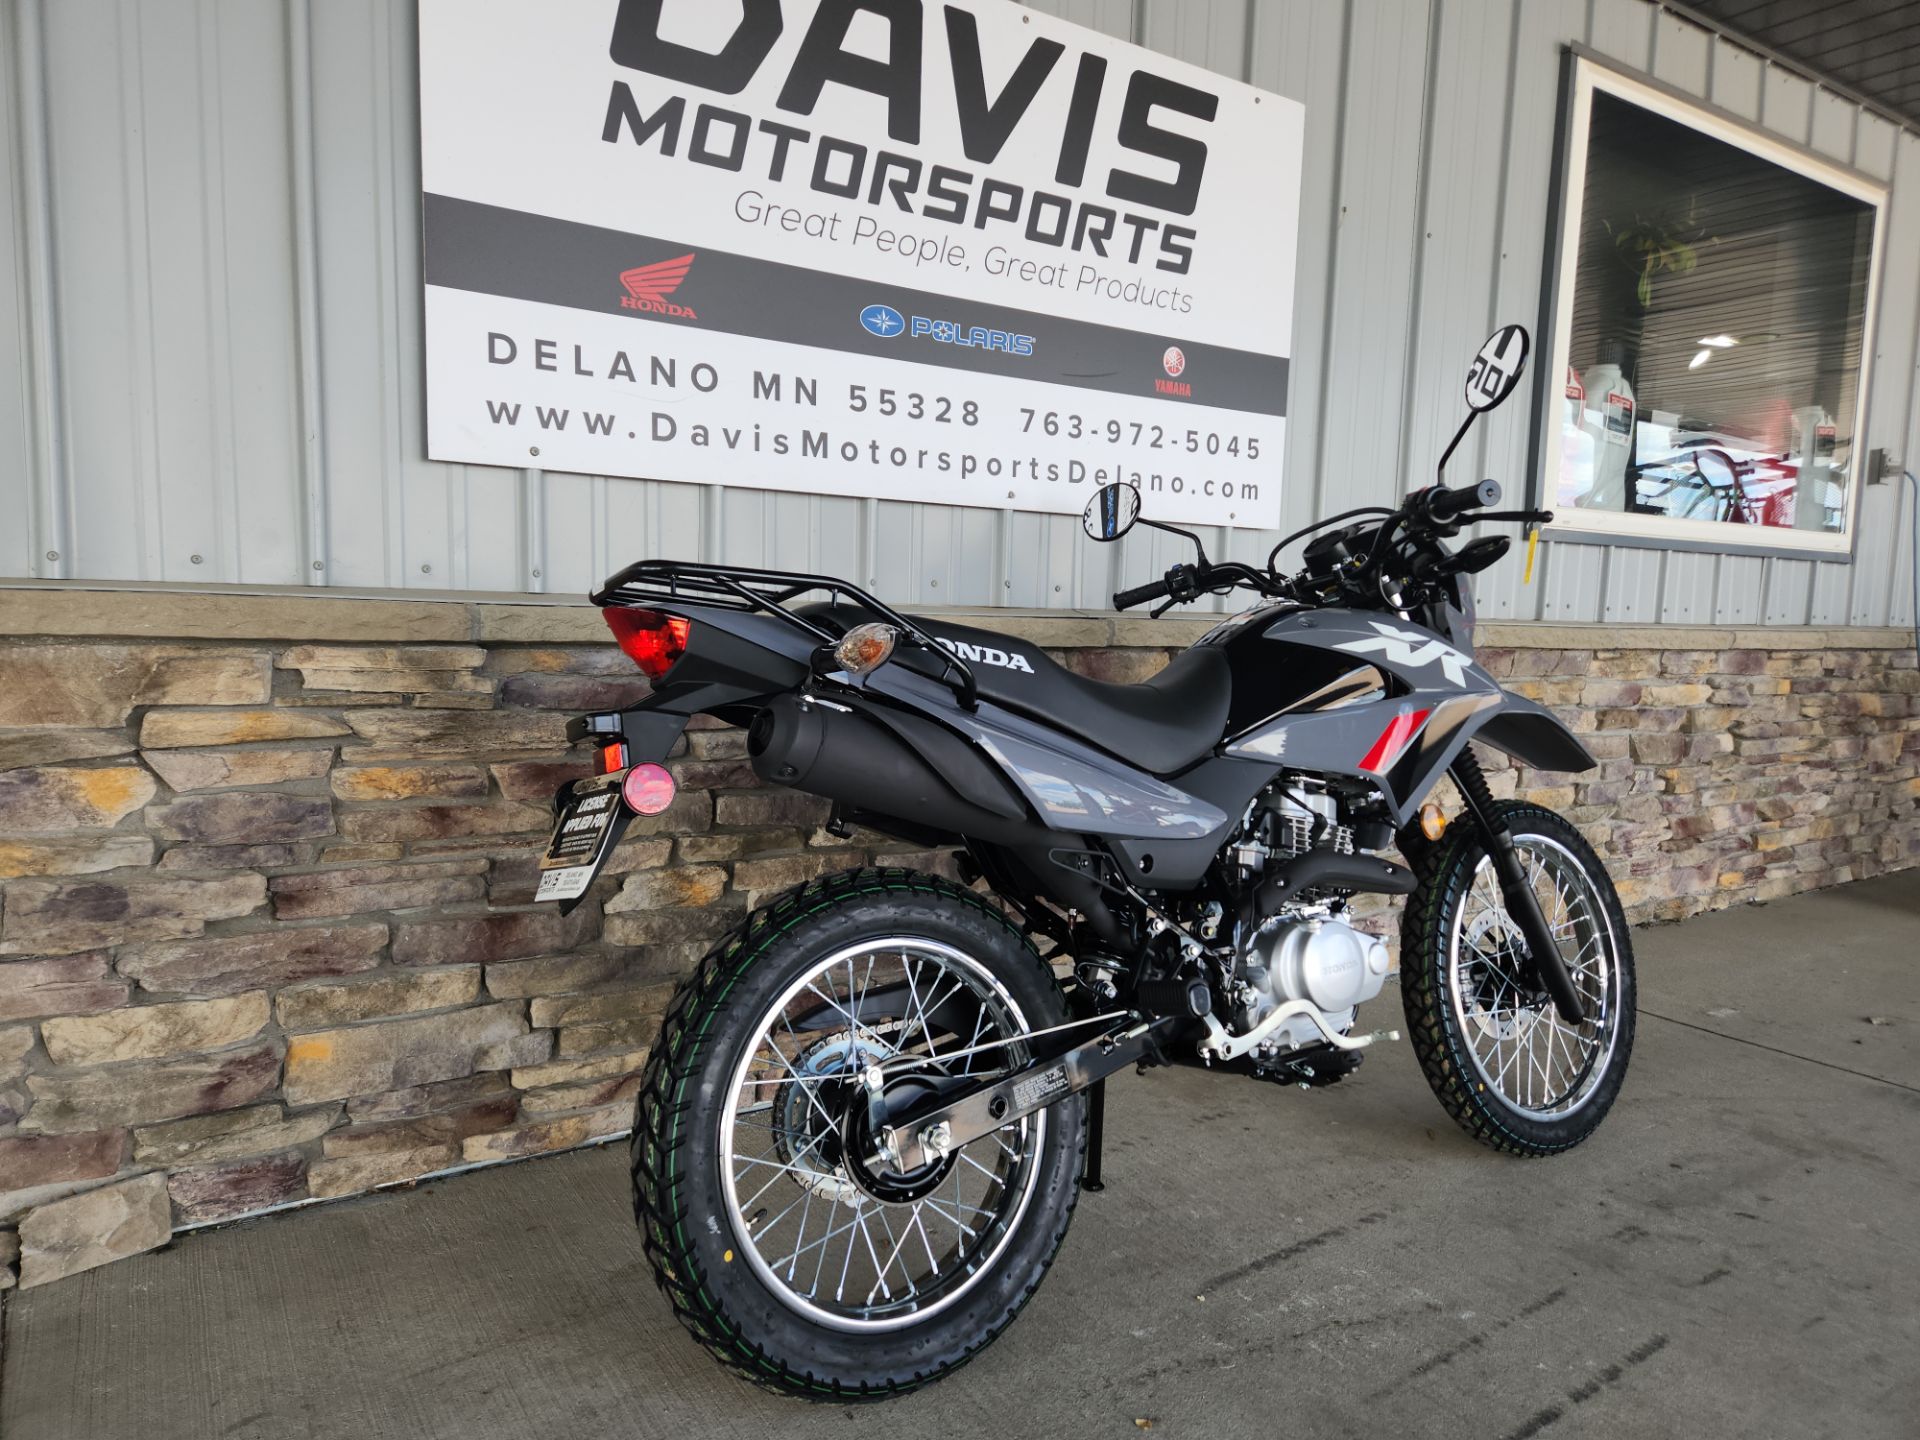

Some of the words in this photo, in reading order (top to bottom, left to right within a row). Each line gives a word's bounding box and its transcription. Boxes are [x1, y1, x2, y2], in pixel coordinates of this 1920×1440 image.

[601, 80, 1197, 275] MOTORSPORTS
[735, 190, 842, 241] Great
[853, 214, 970, 273] People,
[984, 246, 1068, 288] Great
[1076, 266, 1193, 313] Products
[620, 296, 698, 319] HONDA
[911, 316, 1034, 356] POLARIS
[487, 331, 719, 393] DELANO
[753, 370, 818, 406] MN
[848, 384, 979, 427] 55328
[1019, 408, 1261, 461] 763-972-5045
[1155, 379, 1191, 398] YAMAHA
[486, 400, 1259, 500] www.DavisMotorsportsDelano.com
